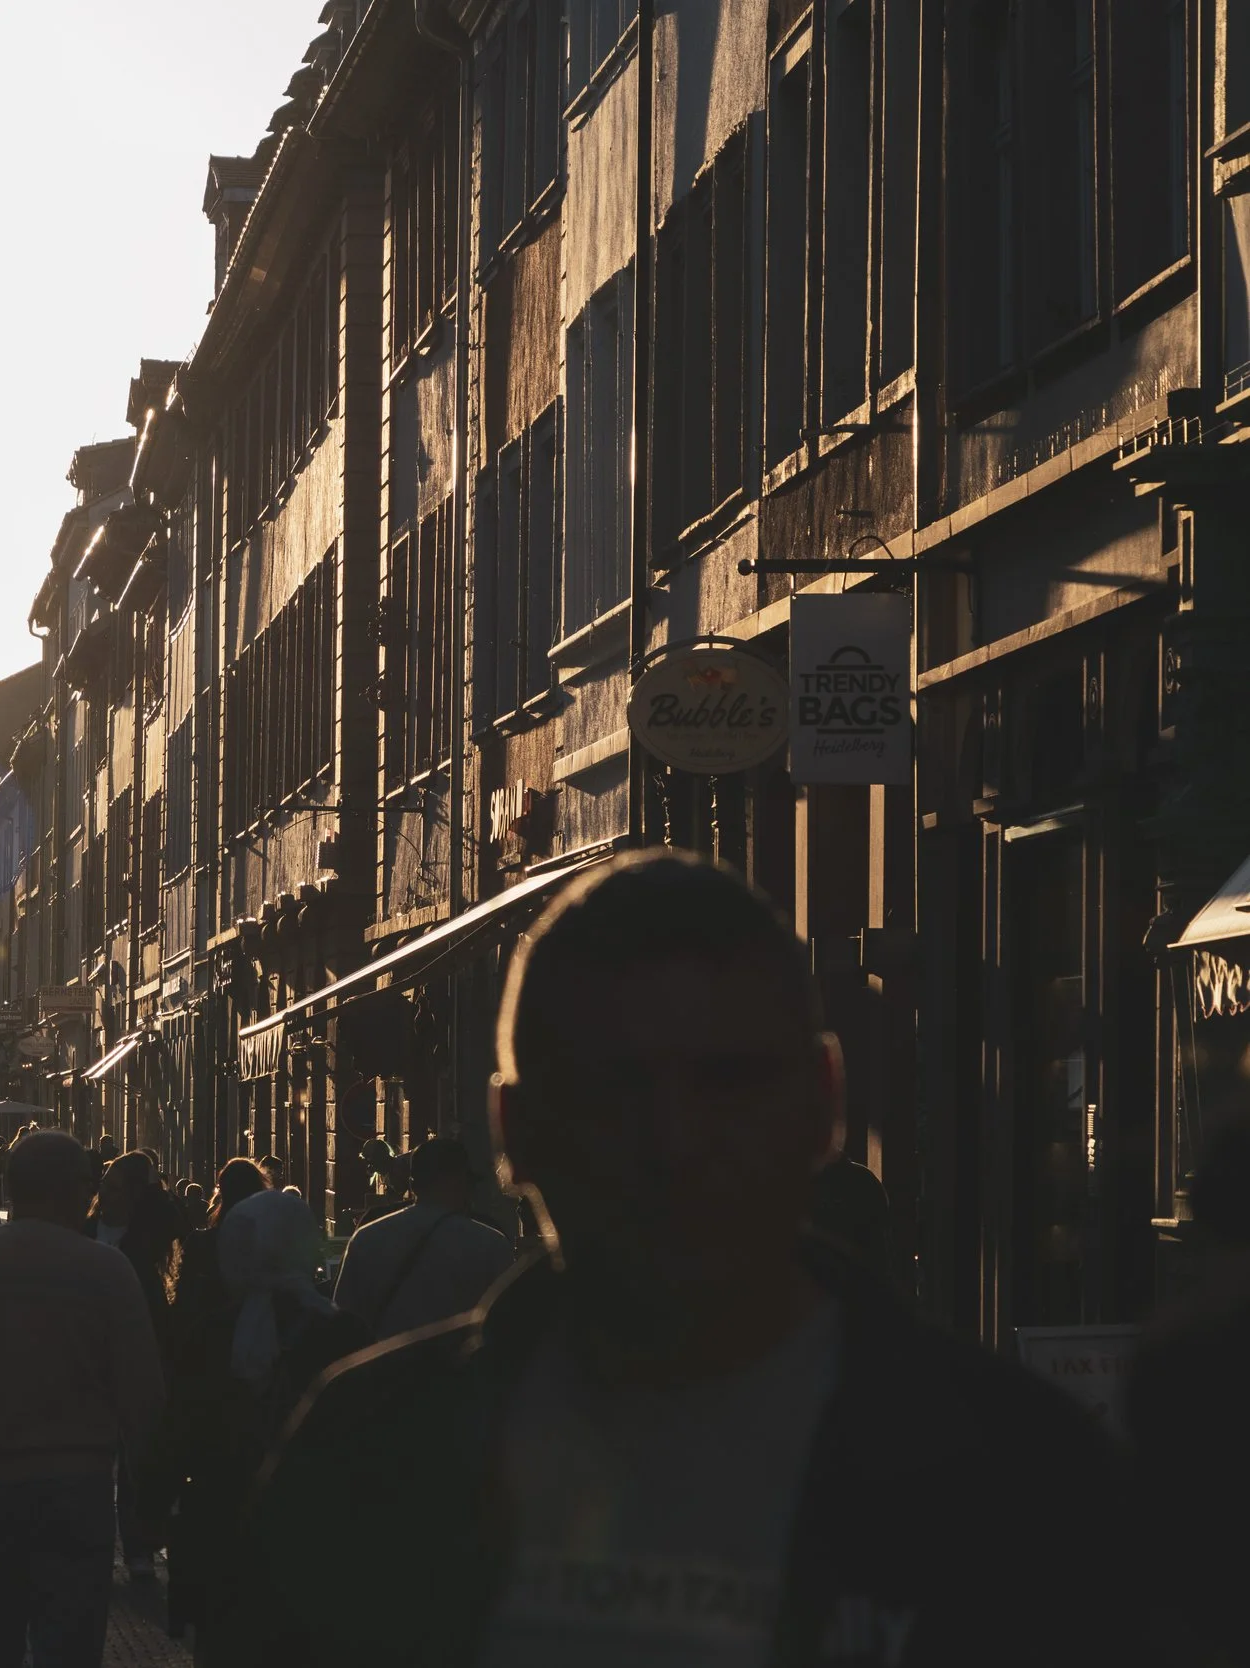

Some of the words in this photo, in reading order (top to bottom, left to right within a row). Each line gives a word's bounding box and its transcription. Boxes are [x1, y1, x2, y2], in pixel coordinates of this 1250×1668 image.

[799, 673, 901, 693] TRENDY
[647, 693, 778, 729] Bubble's
[799, 696, 902, 726] BAGS
[813, 737, 886, 759] Heidelberg
[42, 987, 93, 997] BERNSTEIN
